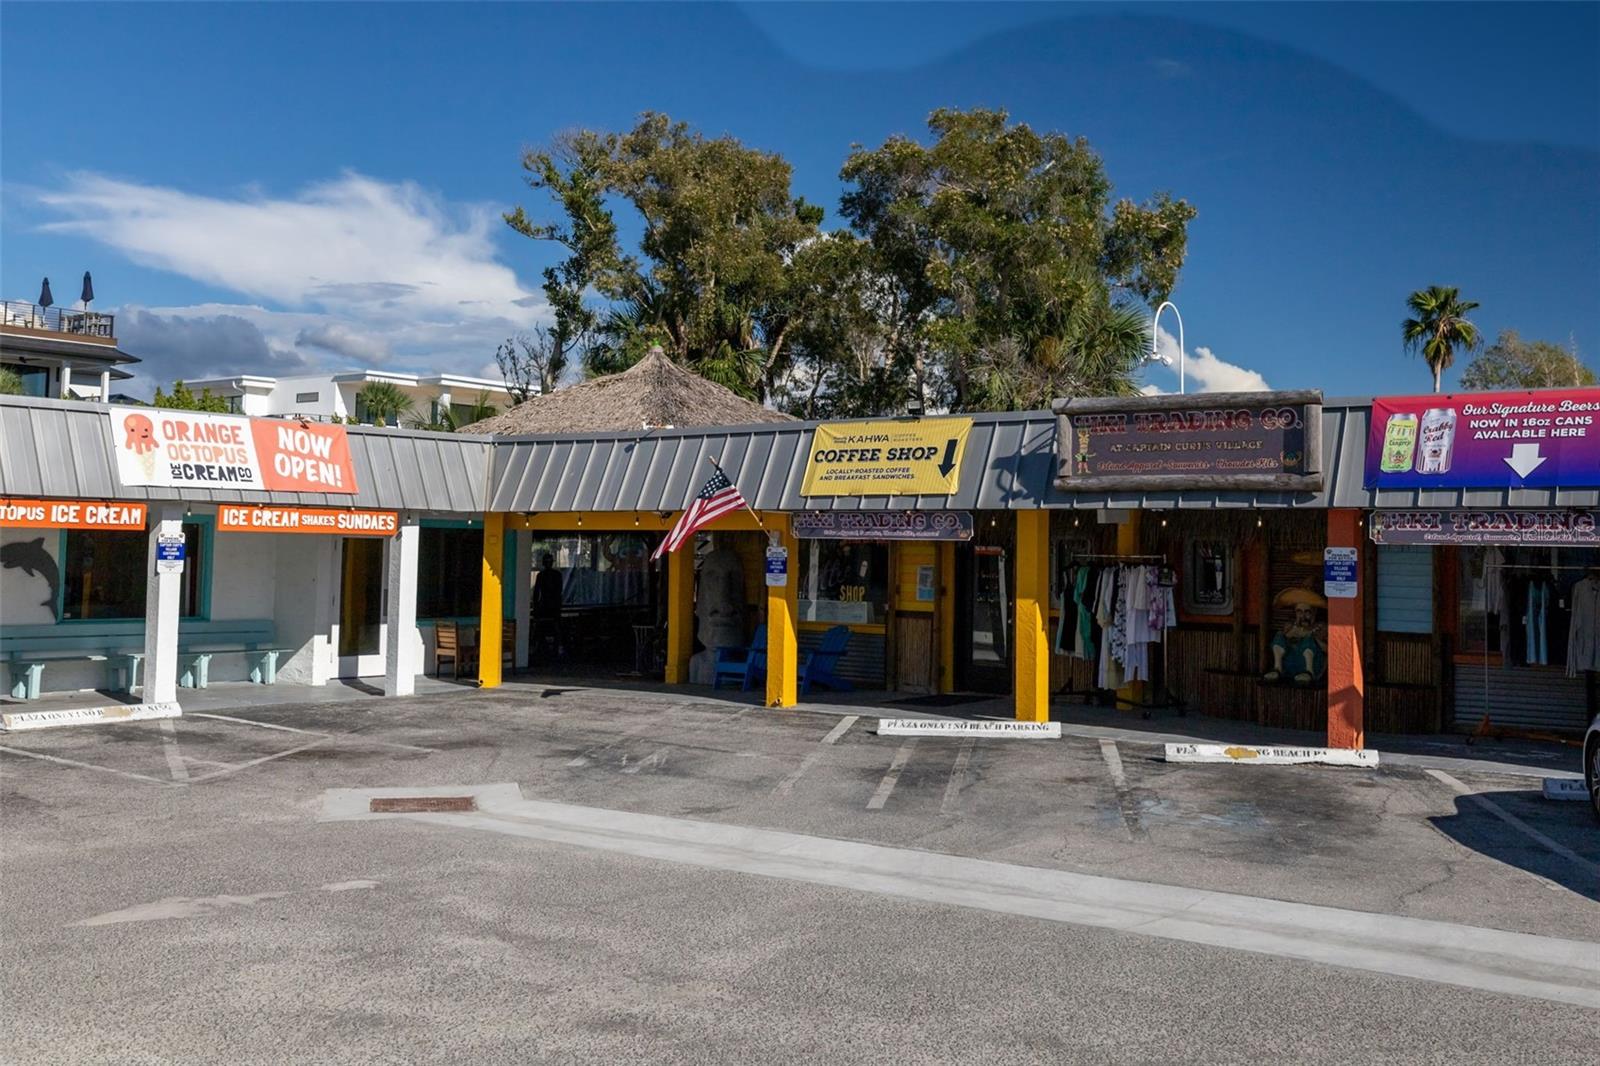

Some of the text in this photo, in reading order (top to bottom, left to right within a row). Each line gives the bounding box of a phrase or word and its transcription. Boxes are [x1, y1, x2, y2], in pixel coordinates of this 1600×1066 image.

[1463, 400, 1600, 418] Our Signature Beers
[1134, 409, 1253, 433] TRADING
[1260, 408, 1304, 430] CO.
[1423, 421, 1454, 435] Crabby
[1470, 416, 1593, 428] NOW IN 16oz CANS
[162, 420, 245, 445] ORANGE
[847, 435, 890, 444] KAHWA
[1474, 428, 1586, 439] AVAILABLE HERE
[278, 426, 333, 460] NOW
[1216, 440, 1263, 450] VILLAGE
[167, 443, 249, 464] OCTOPUS
[814, 446, 938, 464] COFFEE SHOP
[170, 463, 253, 482] ICE CREAM CO
[274, 453, 343, 488] OPEN!
[51, 504, 80, 523] ICE
[85, 505, 142, 524] CREAM
[223, 509, 395, 530] ICE CREAM SHAKES SUNDAES
[838, 513, 926, 529] TRADING
[930, 513, 964, 529] CO.
[1382, 512, 1596, 532] TIKI TRADING
[840, 585, 865, 602] SHOP
[954, 721, 968, 729] NO
[1004, 723, 1049, 731] PARKING
[1273, 749, 1311, 758] BEACH
